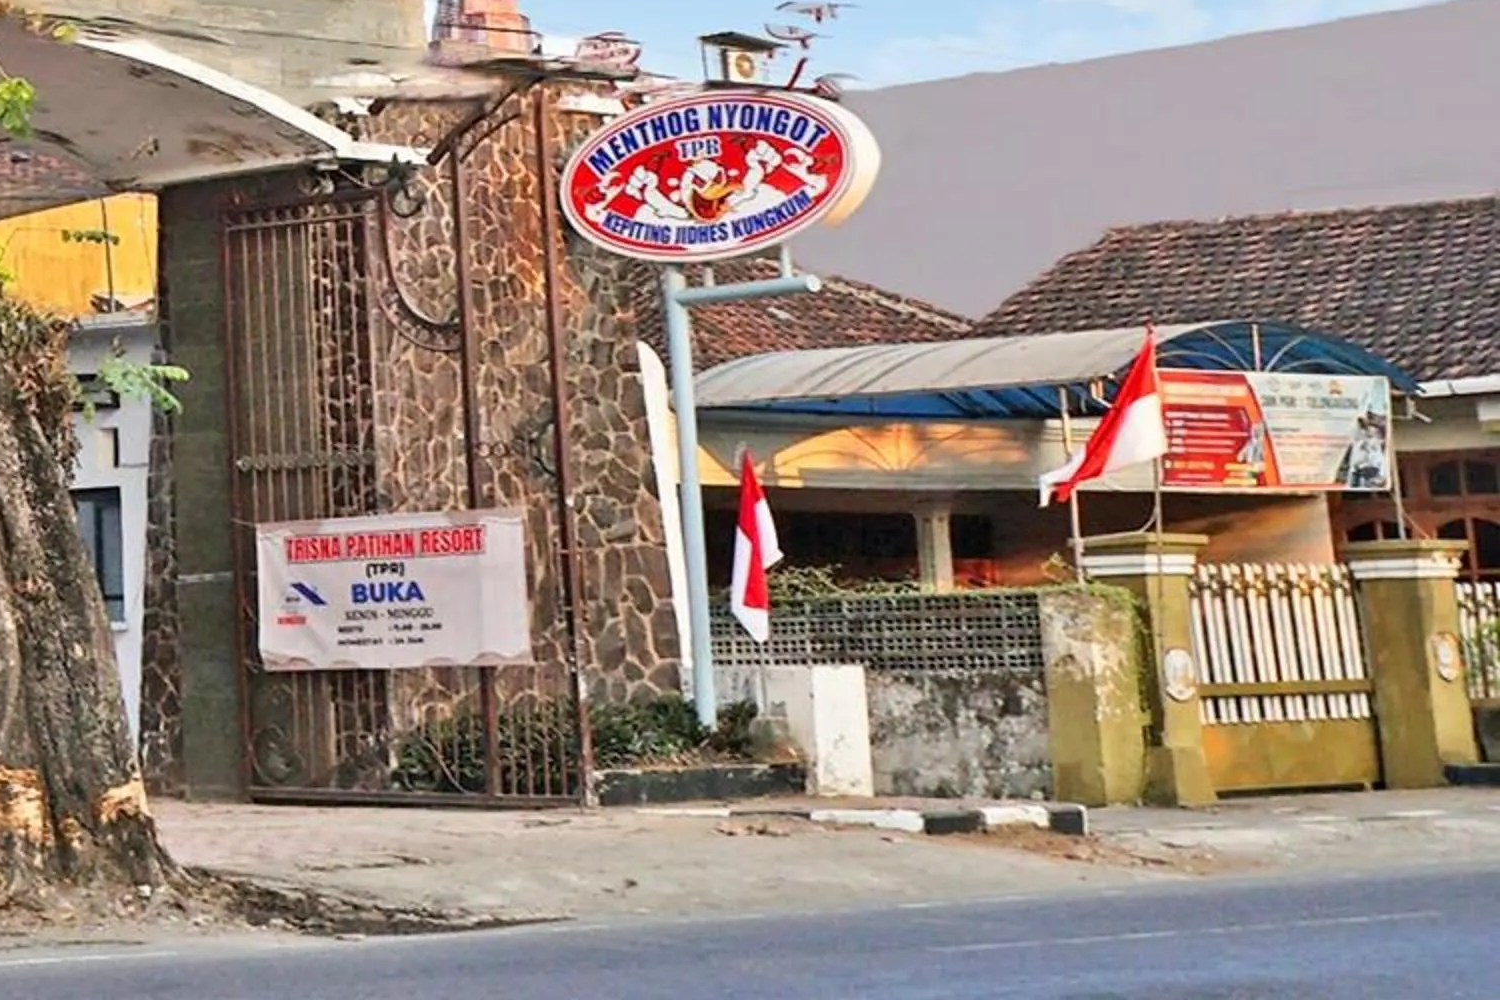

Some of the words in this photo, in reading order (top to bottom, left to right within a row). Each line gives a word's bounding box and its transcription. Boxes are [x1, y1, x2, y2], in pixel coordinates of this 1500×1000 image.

[586, 108, 700, 176] MENTHOG
[707, 103, 830, 149] NYONGOT
[676, 136, 721, 159] TPR
[602, 211, 670, 244] KEPITING
[732, 190, 813, 239] KUNGKUM
[284, 535, 342, 563] TRISNA
[346, 530, 415, 559] PATIHAN
[421, 525, 485, 555] RESORT
[366, 562, 405, 578] (TPR)
[351, 581, 425, 604] BUKA
